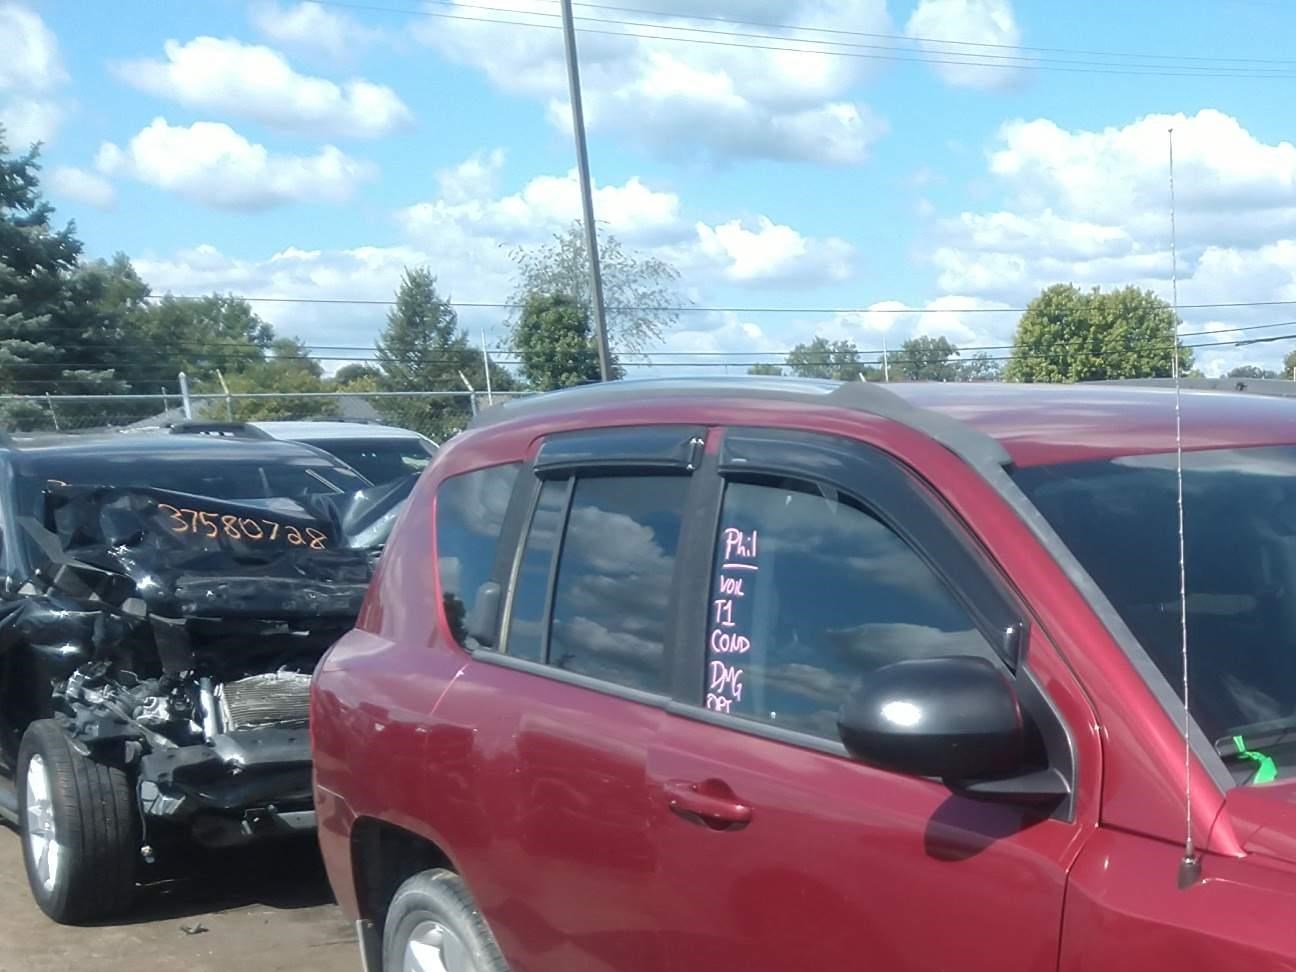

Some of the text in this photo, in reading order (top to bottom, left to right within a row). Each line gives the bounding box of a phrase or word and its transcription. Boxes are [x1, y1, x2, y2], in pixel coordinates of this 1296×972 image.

[158, 503, 328, 550] 37580728
[725, 527, 757, 560] Phil
[714, 599, 735, 626] T1
[711, 628, 750, 653] COND
